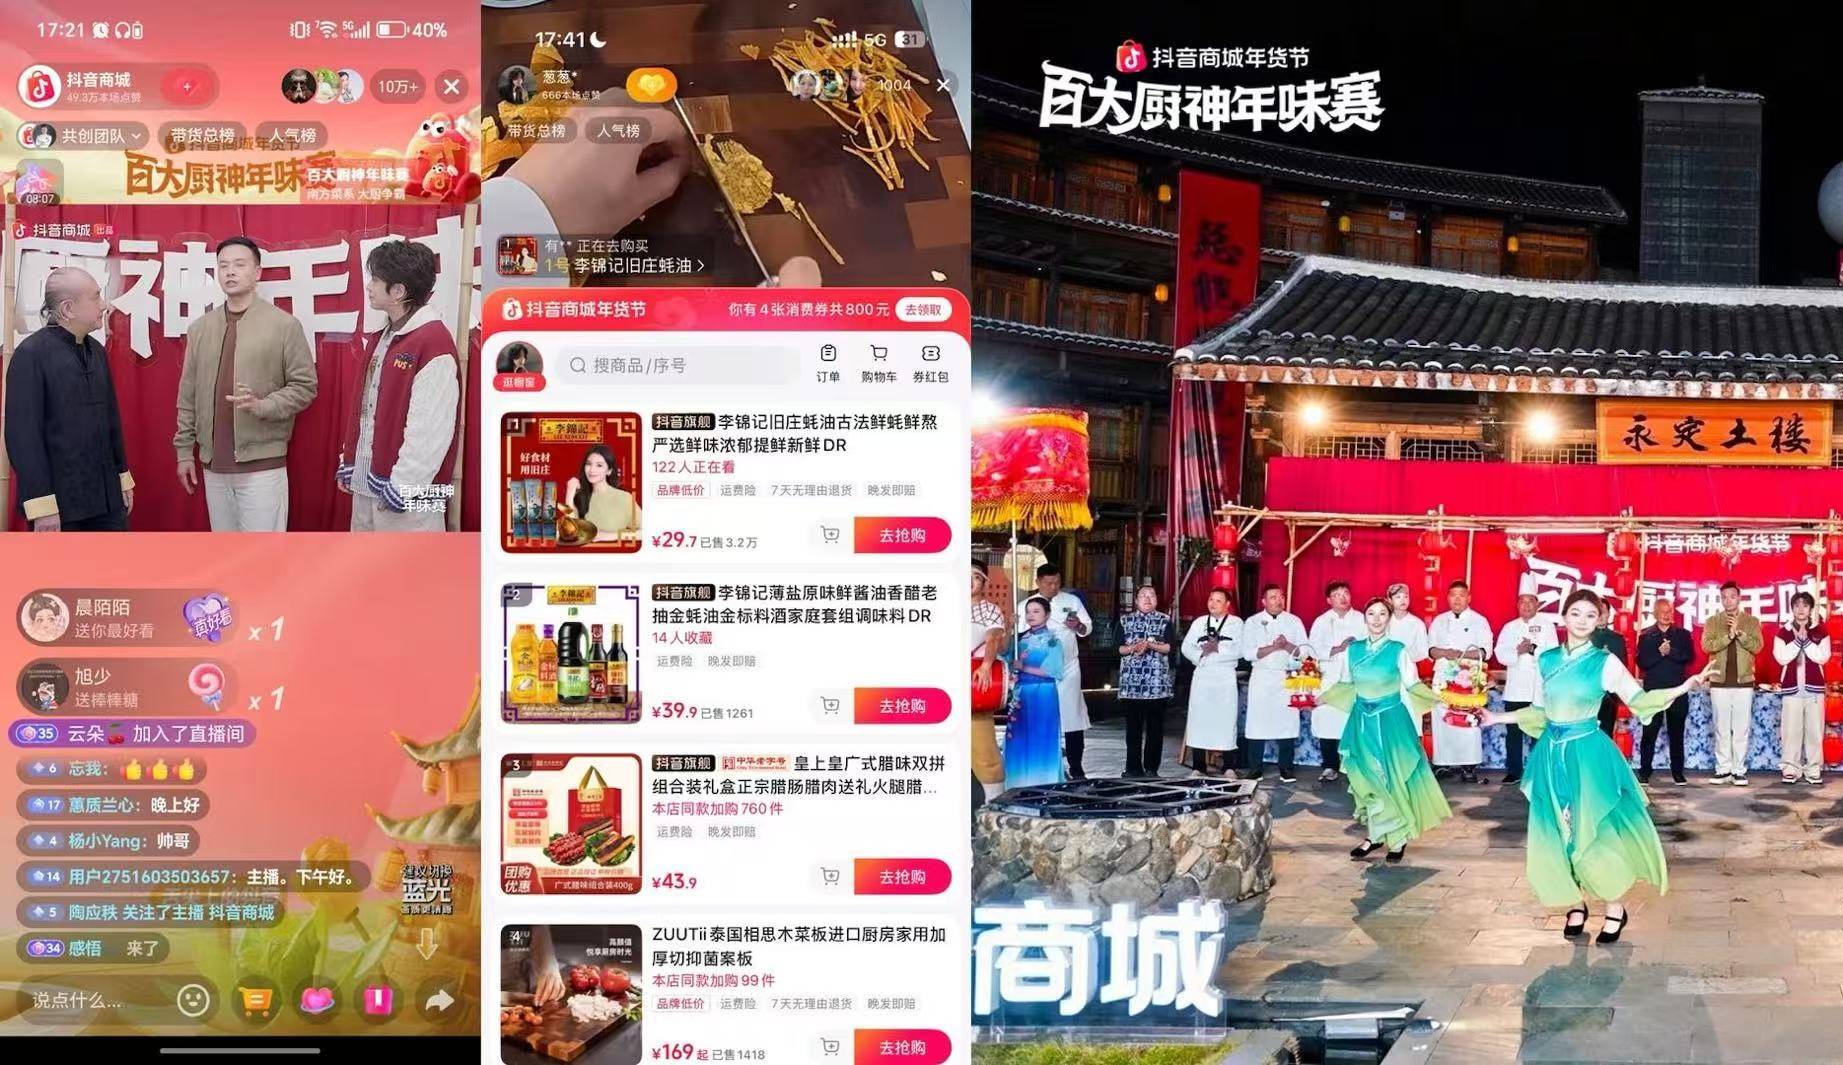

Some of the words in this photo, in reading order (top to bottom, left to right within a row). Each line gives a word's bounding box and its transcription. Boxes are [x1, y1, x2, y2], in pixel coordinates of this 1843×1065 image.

[37, 22, 84, 38] 17:21
[343, 22, 354, 30] 5G
[412, 23, 448, 38] 40%
[535, 32, 585, 48] 17:41
[865, 33, 887, 47] 5G
[902, 33, 917, 46] 31
[66, 71, 131, 88] 抖音商城
[378, 80, 418, 94] 10万+
[880, 78, 912, 92] 1004
[62, 128, 126, 144] 共创团队
[171, 127, 236, 143] 带货总榜
[268, 127, 317, 143] 人气榜
[508, 124, 566, 138] 带货总榜
[598, 124, 641, 138] 人气榜
[26, 194, 54, 204] 08:07
[577, 239, 648, 254] 正在去购买
[545, 259, 569, 274] 1号
[575, 258, 692, 274] 李锦记旧庄蚝油
[526, 301, 646, 318] 抖音商城年货节
[905, 302, 942, 316] 去领取
[593, 357, 687, 375] 搜商品/序号
[816, 370, 841, 384] 订单
[861, 370, 898, 384] 购物车
[913, 370, 949, 384] 券红包
[656, 415, 711, 428] 抖音旗舰
[718, 413, 938, 430] 李锦记旧庄蚝油古法鲜蚝鲜熬
[1622, 414, 1812, 457] 永定土楼
[520, 452, 551, 463] 好食材
[652, 460, 735, 474] 122人正在看
[657, 484, 705, 496] 品牌低价
[720, 484, 756, 496] 运费险
[771, 484, 852, 496] 7天无理由退货
[867, 484, 916, 496] 晚发即赔
[652, 530, 697, 549] ¥29.7
[879, 527, 926, 543] 去抢购
[513, 590, 520, 600] 2
[656, 586, 711, 599] 抖音旗舰
[718, 584, 938, 601] 李锦记薄盐原味鲜酱油香醋老
[75, 599, 130, 616] 晨陌陌
[194, 607, 234, 638] 真好看
[75, 624, 153, 639] 送你最好看
[657, 655, 693, 667] 运费险
[708, 655, 756, 667] 晚发即赔
[75, 668, 111, 685] 旭少
[75, 693, 138, 708] 送棒棒糖
[652, 702, 697, 719] ¥39.9
[879, 698, 926, 715] 去抢购
[38, 728, 53, 739] 35
[68, 726, 104, 743] 云朵
[133, 725, 244, 743] 加入了直播间
[49, 763, 56, 774] 6
[513, 760, 520, 770] 3
[656, 757, 711, 770] 抖音旗舰
[794, 755, 945, 771] 皇上皇广式腊味双拼
[49, 800, 60, 811] 17
[151, 797, 200, 814] 晚上好
[657, 826, 693, 838] 运费险
[708, 826, 756, 838] 晚发即赔
[49, 835, 57, 846] 4
[157, 832, 190, 849] 帅哥
[47, 871, 60, 882] 14
[504, 866, 531, 878] 团购
[652, 873, 697, 890] ¥43.9
[879, 869, 926, 885] 去抢购
[402, 878, 452, 904] 蓝光
[504, 881, 531, 892] 优惠
[49, 907, 57, 918] 5
[123, 905, 203, 921] 关注了主播
[209, 905, 275, 921] 抖音商城
[512, 931, 520, 942] 4
[46, 943, 60, 954] 34
[69, 940, 101, 957] 感悟
[127, 940, 158, 957] 来了
[652, 950, 753, 967] 厚切抑菌案板
[973, 898, 1226, 1018] 商城
[657, 998, 705, 1010] 品牌低价
[720, 998, 756, 1010] 运费险
[771, 998, 852, 1010] 7天无理由退货
[867, 998, 916, 1010] 晚发即赔
[652, 1043, 693, 1060] ¥169
[697, 1050, 709, 1061] 起
[879, 1041, 926, 1056] 去抢购
